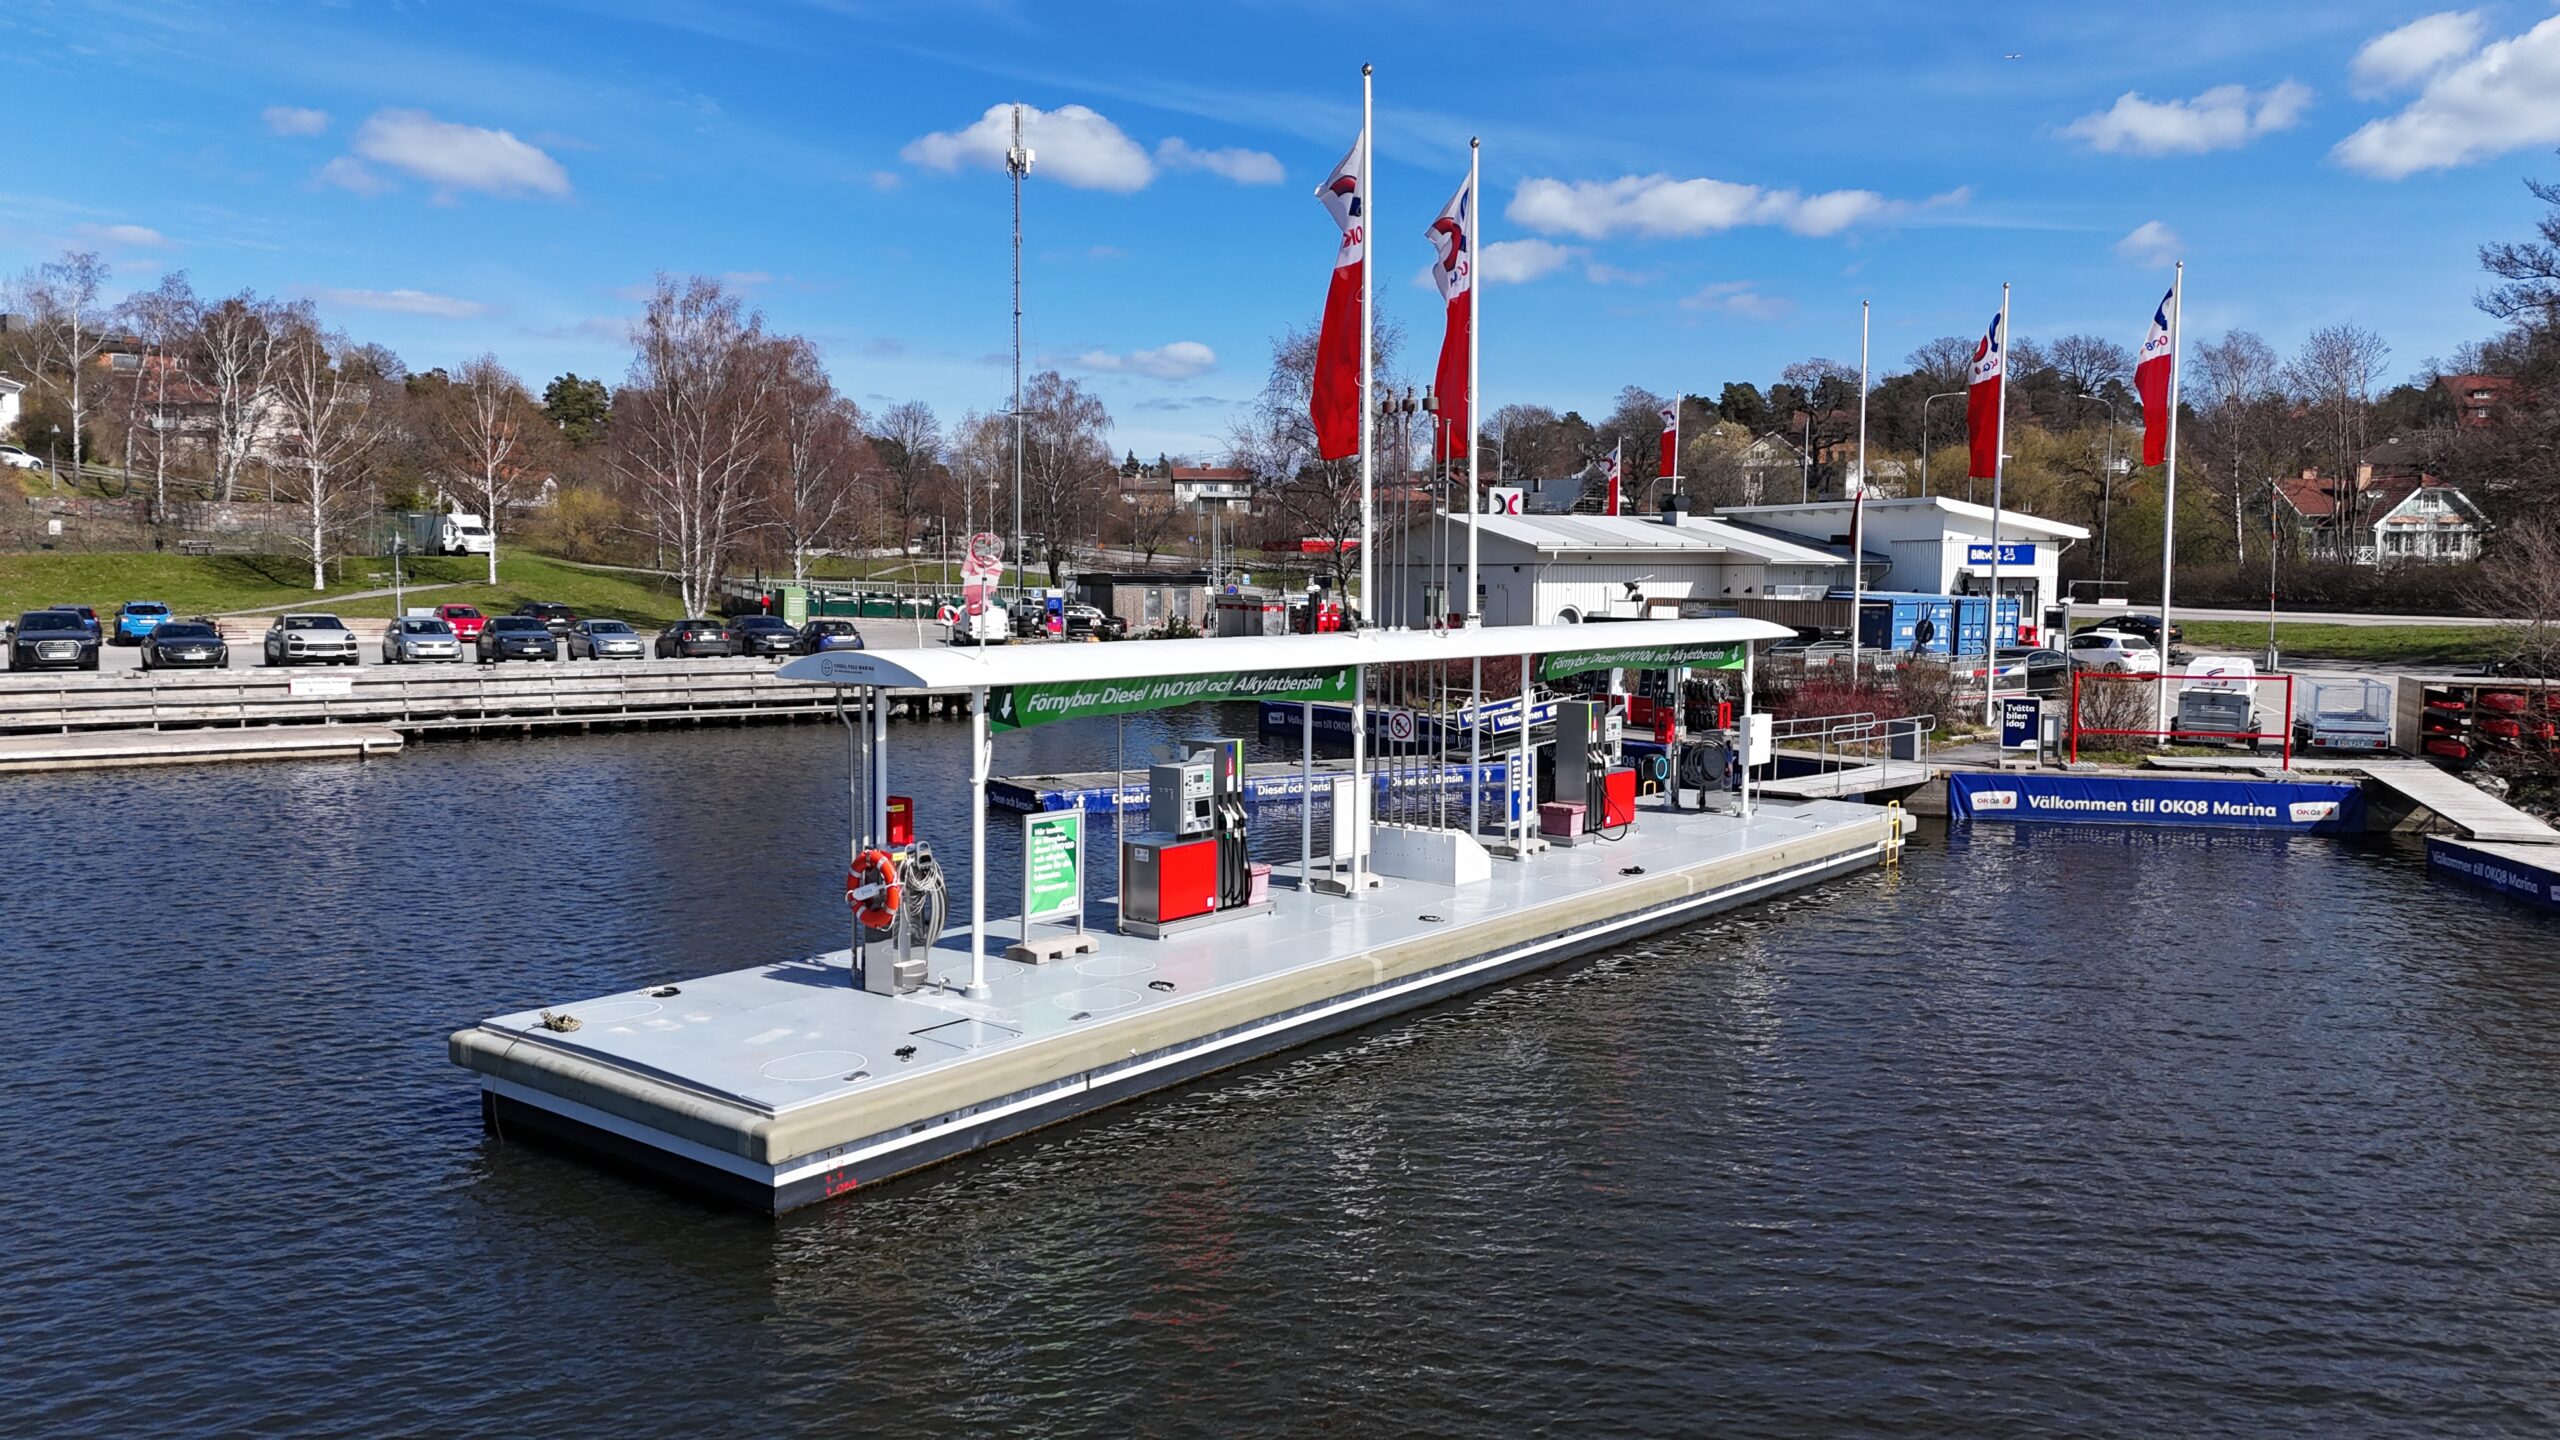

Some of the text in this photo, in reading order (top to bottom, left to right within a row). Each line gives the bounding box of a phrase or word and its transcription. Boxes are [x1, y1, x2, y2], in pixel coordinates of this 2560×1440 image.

[1551, 655, 1588, 671] Förnybar
[1589, 652, 1618, 664] Diesel
[1027, 674, 1324, 714] Förnybar Diesel HVO100 och Alkylatbensin
[2006, 704, 2035, 712] Tvätta
[2006, 712, 2028, 720] bilen
[2006, 720, 2026, 729] idag
[1257, 783, 1286, 796] Diesel
[1288, 782, 1304, 793] och
[2028, 795, 2277, 817] Välkommen till OKQ8 Marina
[2432, 850, 2538, 894] Välkommen till OKQ8 Marina
